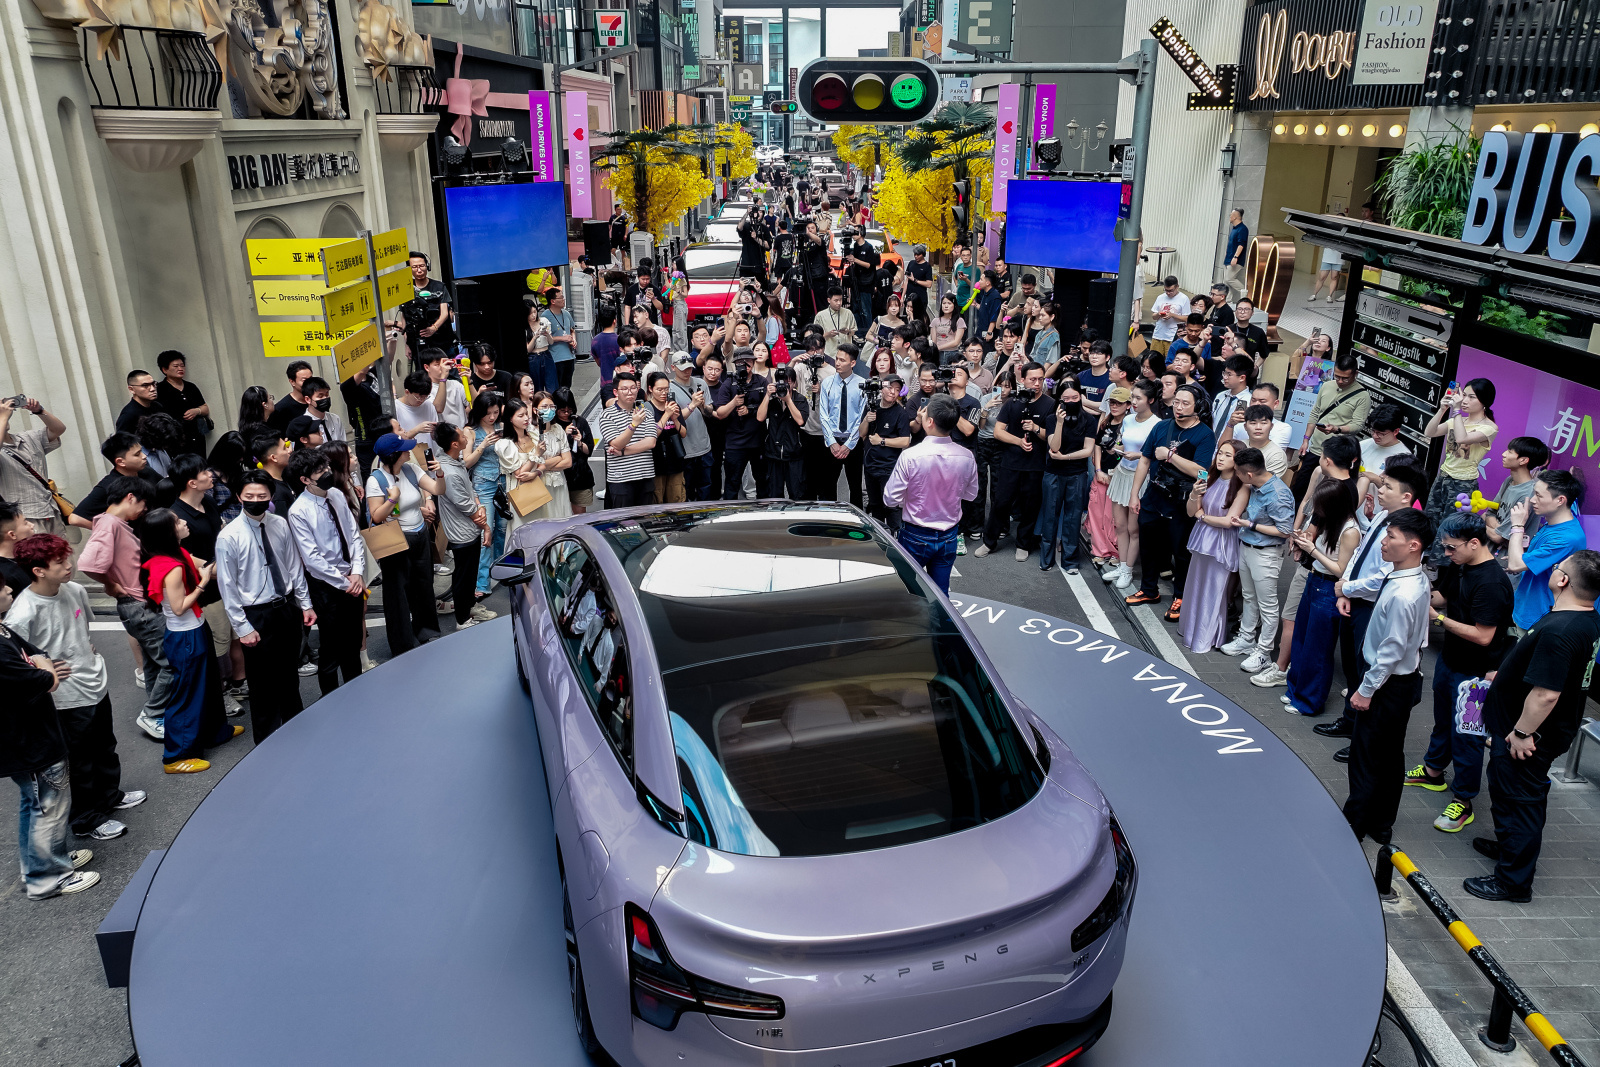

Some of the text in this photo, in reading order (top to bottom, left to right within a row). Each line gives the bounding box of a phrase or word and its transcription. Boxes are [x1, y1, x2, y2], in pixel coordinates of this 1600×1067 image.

[600, 16, 622, 46] 7
[1364, 32, 1426, 50] Fashion
[1163, 27, 1222, 98] Double Bistro
[1292, 30, 1356, 80] DOUBL
[1041, 98, 1049, 122] MONA
[538, 130, 546, 158] DRIVES
[227, 155, 259, 190] BIG
[260, 153, 288, 186] DAY
[575, 151, 585, 196] MONA
[999, 144, 1010, 190] MONA
[1462, 131, 1600, 262] BUS
[279, 294, 309, 302] Dressing
[1374, 334, 1394, 351] Palais
[1132, 663, 1264, 755] MONA
[863, 944, 1009, 984] XPENG
[756, 1027, 783, 1038] 小鹏
